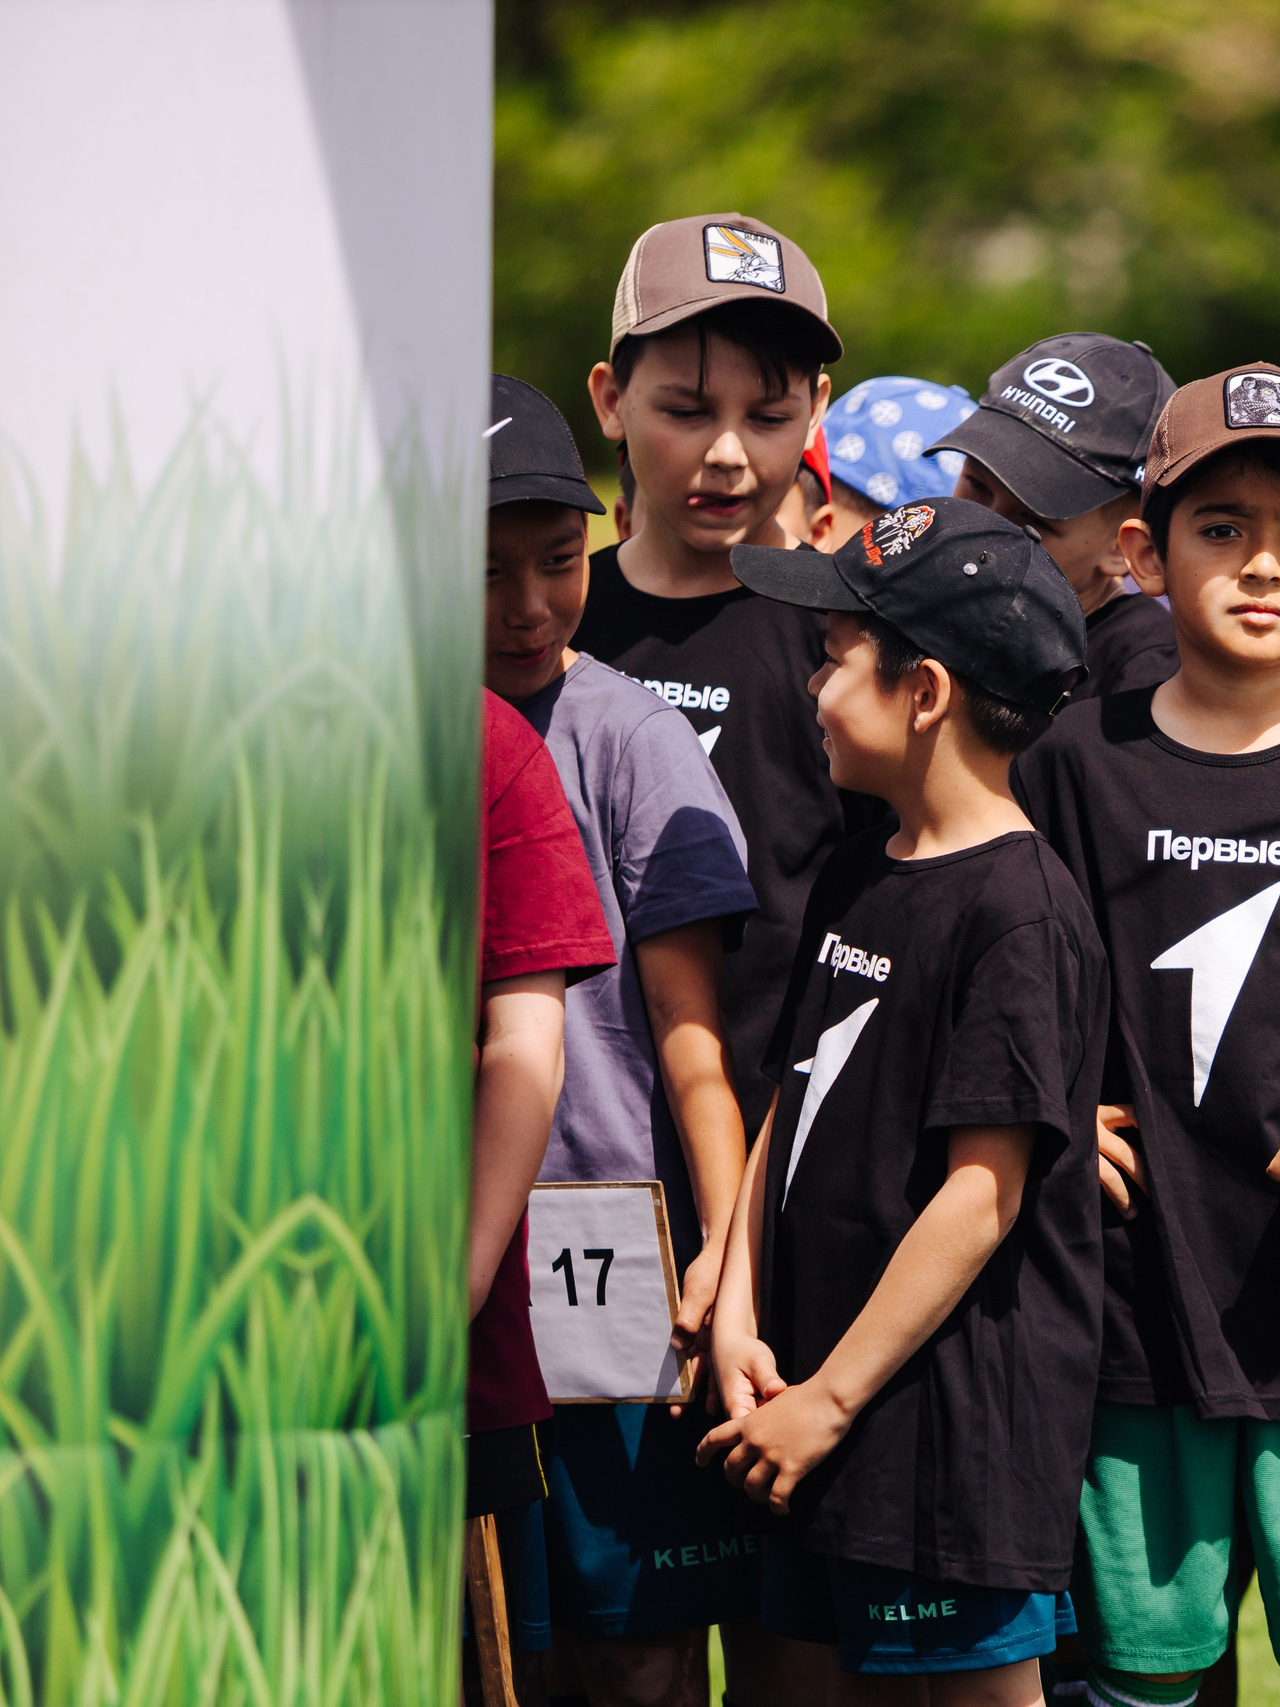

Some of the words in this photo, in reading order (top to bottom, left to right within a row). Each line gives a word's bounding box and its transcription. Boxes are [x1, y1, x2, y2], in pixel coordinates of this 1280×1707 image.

[1000, 385, 1077, 433] HYUNDAI
[817, 932, 891, 982] Первые
[552, 1248, 614, 1306] 17
[654, 1534, 758, 1569] KELME
[868, 1599, 957, 1621] KELME
